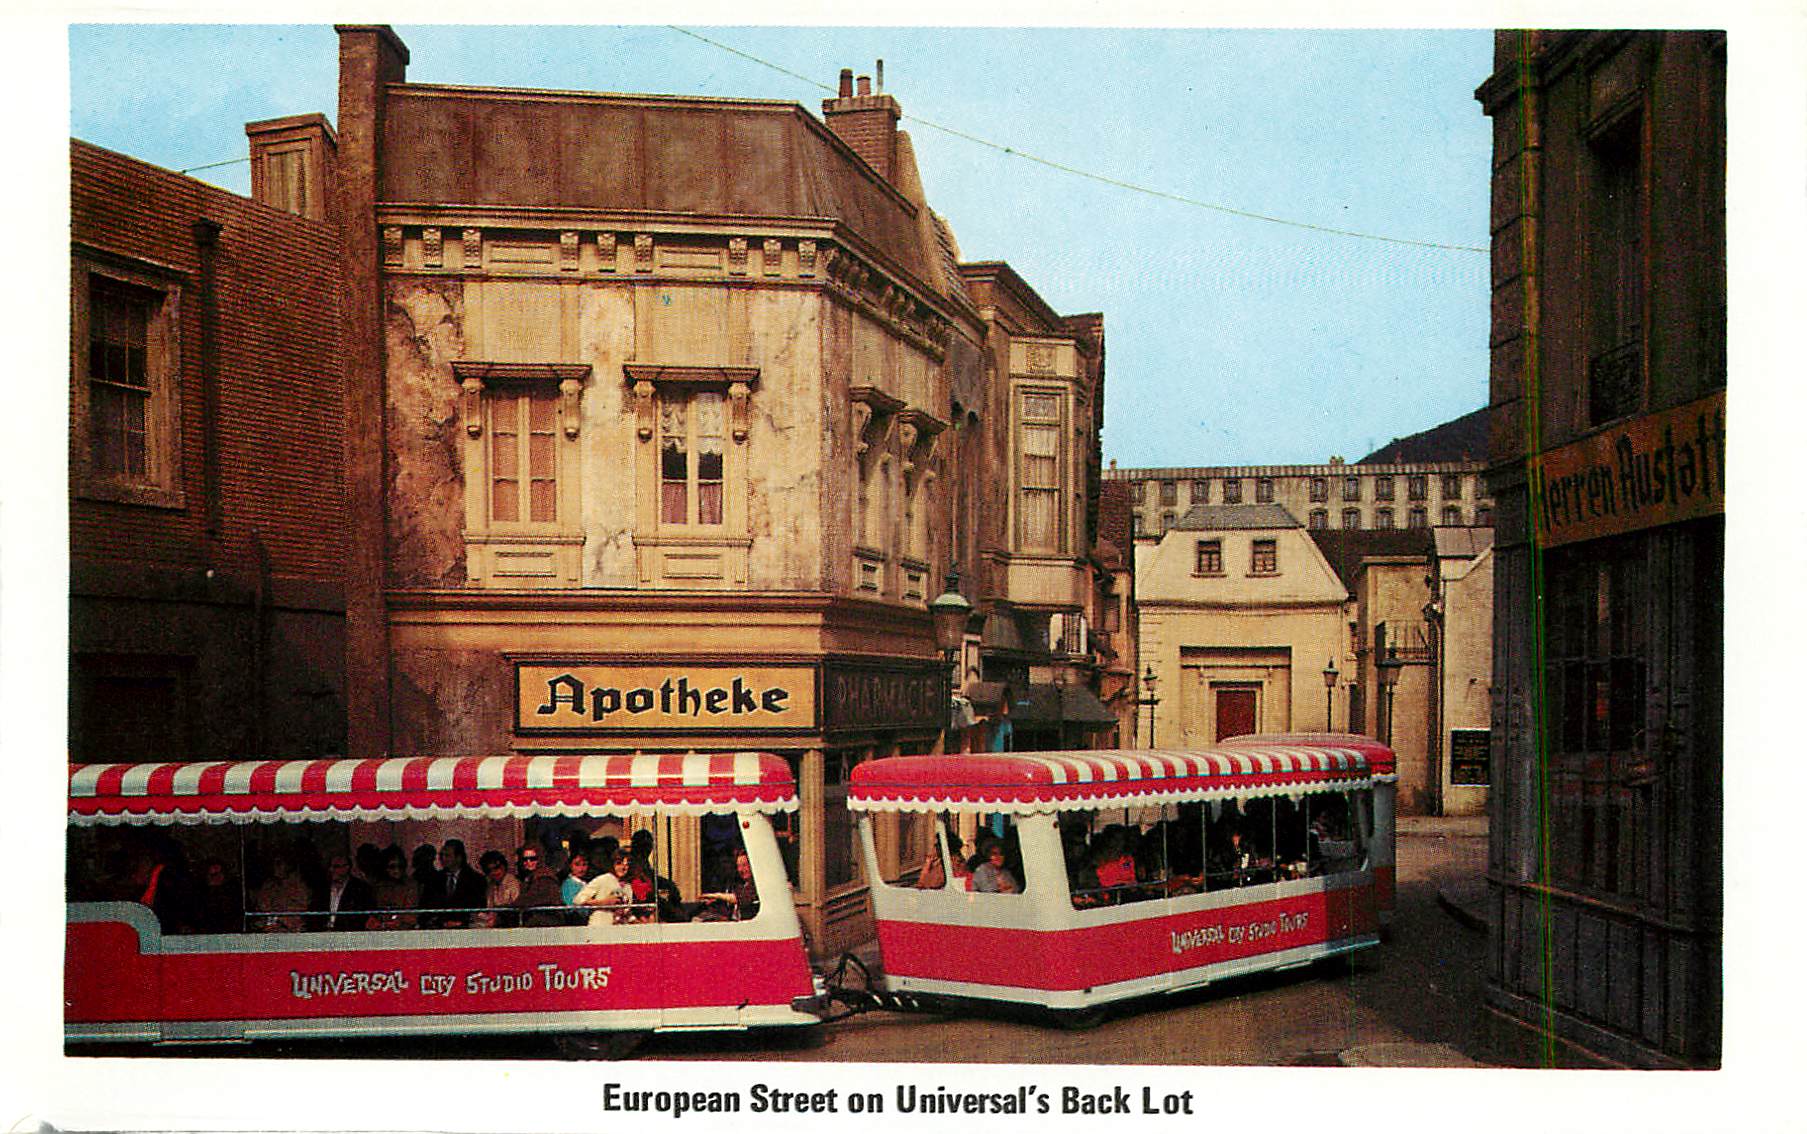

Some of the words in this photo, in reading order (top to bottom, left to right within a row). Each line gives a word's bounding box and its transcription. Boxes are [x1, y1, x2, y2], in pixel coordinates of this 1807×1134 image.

[537, 673, 790, 721] Apotheke
[1280, 912, 1309, 933] TOURS
[290, 970, 409, 998] UNIVERSAL
[466, 972, 533, 994] STUDIO
[537, 962, 612, 992] TOURS
